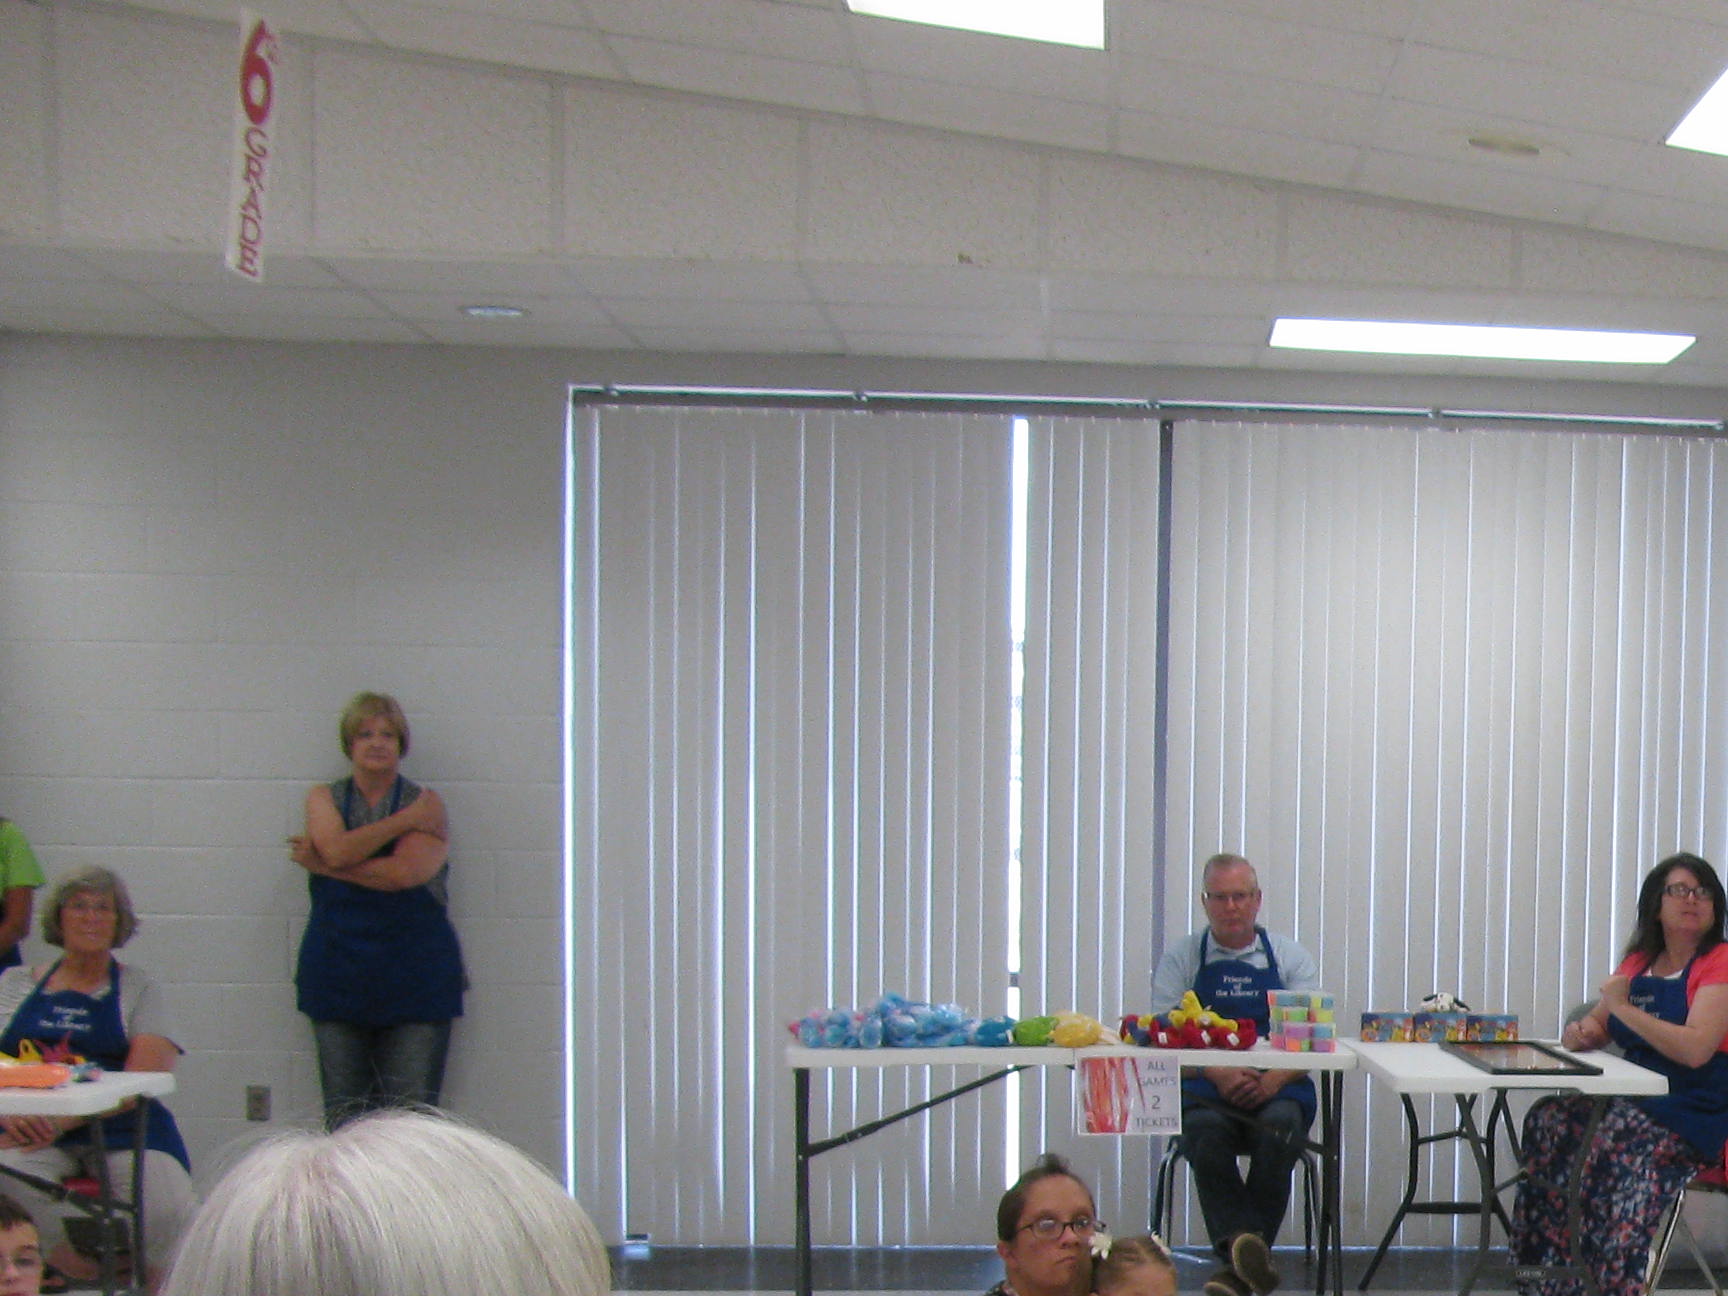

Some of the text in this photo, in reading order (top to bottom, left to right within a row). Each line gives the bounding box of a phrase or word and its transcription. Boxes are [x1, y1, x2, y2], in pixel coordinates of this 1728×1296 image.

[1147, 1061, 1166, 1071] ALL
[1151, 1095, 1161, 1110] 2
[1136, 1116, 1179, 1128] TICKETS
